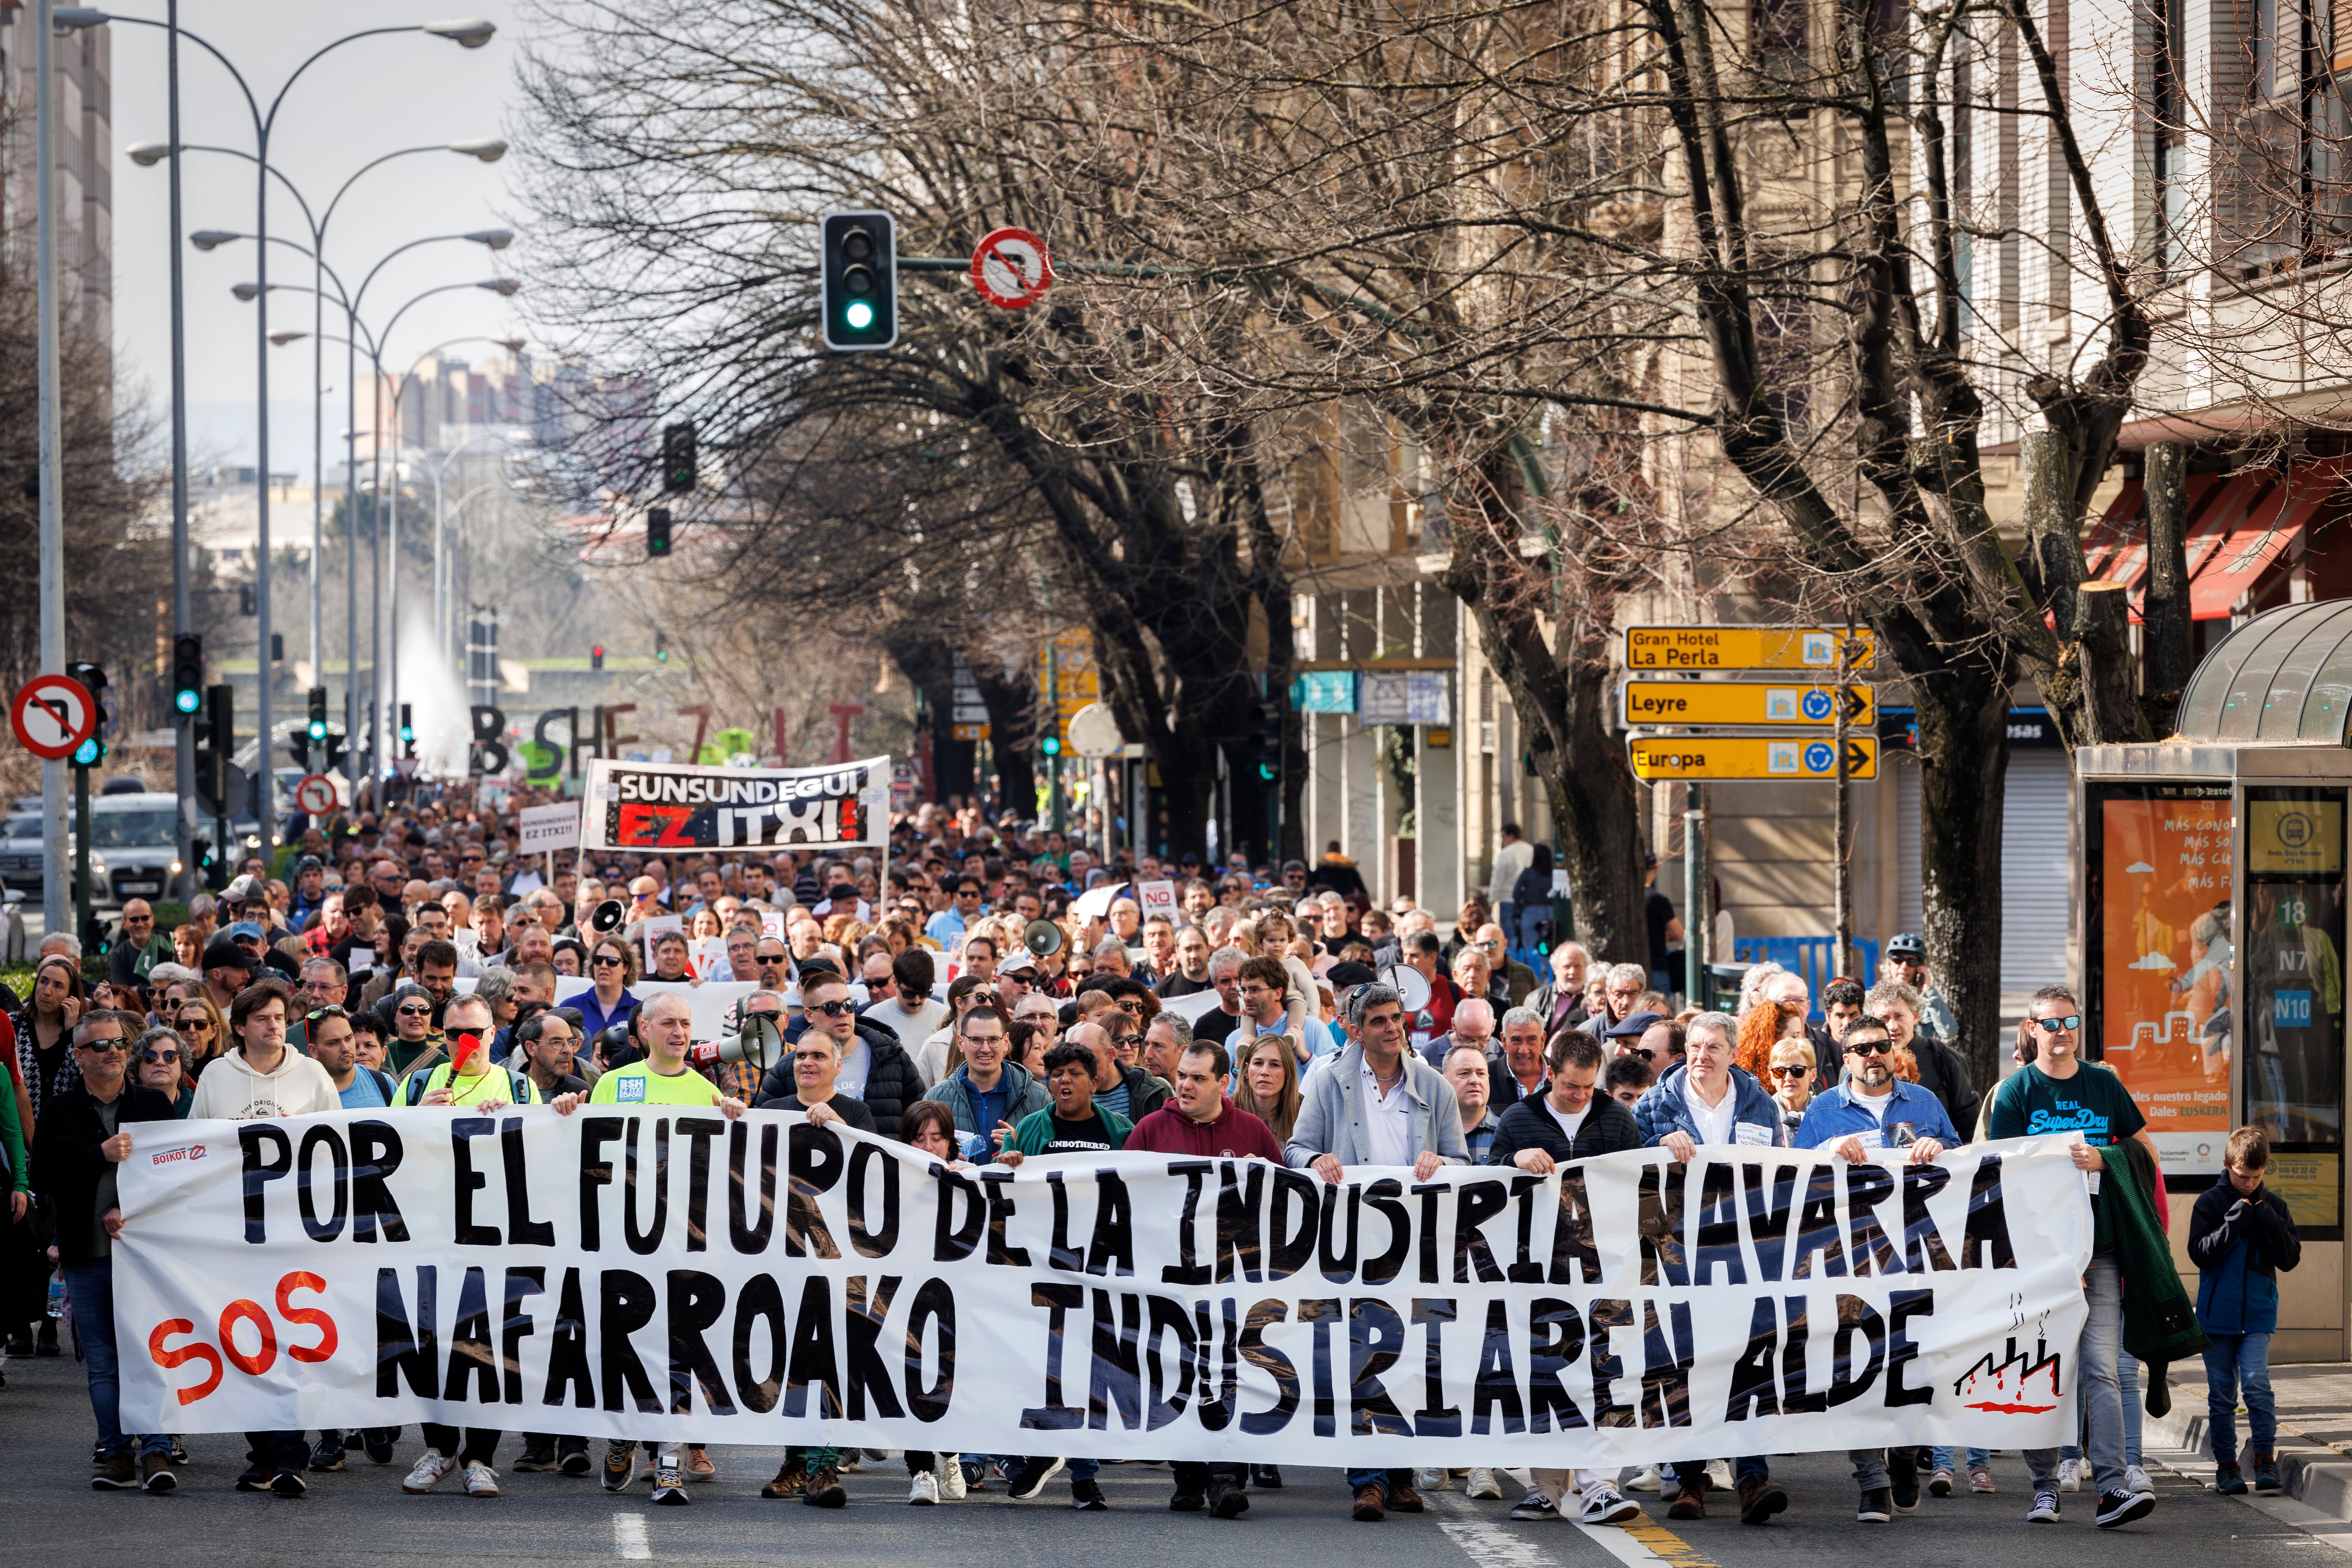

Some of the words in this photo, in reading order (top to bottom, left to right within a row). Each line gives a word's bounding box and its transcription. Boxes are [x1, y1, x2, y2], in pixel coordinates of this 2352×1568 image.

[1634, 633, 1670, 644] Gran
[1678, 633, 1719, 645] Hotel
[1634, 649, 1656, 665] La
[1667, 649, 1719, 665] Perla
[1632, 695, 1687, 714] Leyre
[1637, 751, 1705, 770] Europa
[620, 770, 857, 803] SUNSUNDEGUI
[522, 815, 576, 826] SUNSUNDEGUI
[619, 803, 695, 847] EZ
[718, 799, 857, 847] ITXI!
[2164, 815, 2190, 832] MÁS
[2196, 818, 2230, 832] CONO
[525, 830, 539, 839] EZ
[2184, 832, 2209, 848] MÁS
[2180, 847, 2205, 865] MÁS
[2188, 871, 2214, 888] MÁS
[1145, 891, 1170, 903] NO
[2281, 901, 2305, 924] 18
[2280, 950, 2307, 971] N7
[2276, 998, 2309, 1019] N10
[700, 1046, 715, 1055] LAB
[620, 1078, 644, 1088] BSH
[2131, 1091, 2150, 1101] ales
[2153, 1091, 2191, 1101] nuestro
[2193, 1091, 2227, 1103] legado
[2056, 1101, 2081, 1110] REAL
[2150, 1106, 2177, 1117] Dales
[2180, 1106, 2227, 1116] EUSKERA
[1049, 1140, 1110, 1151] UNBOTHERED
[152, 1150, 187, 1165] BOIKOT
[238, 1120, 411, 1244] POR
[451, 1116, 556, 1247] EL
[580, 1116, 900, 1259] FUTURO
[928, 1161, 1032, 1267] DE
[1046, 1167, 1134, 1276] LA
[1161, 1160, 1603, 1285] INDUSTRIA
[1638, 1153, 2018, 1287] NAVARRA
[148, 1270, 338, 1406] SOS
[376, 1265, 956, 1423] NAFARROAKO
[1019, 1282, 1694, 1438] INDUSTRIAREN
[1724, 1288, 1934, 1424] ALDE
